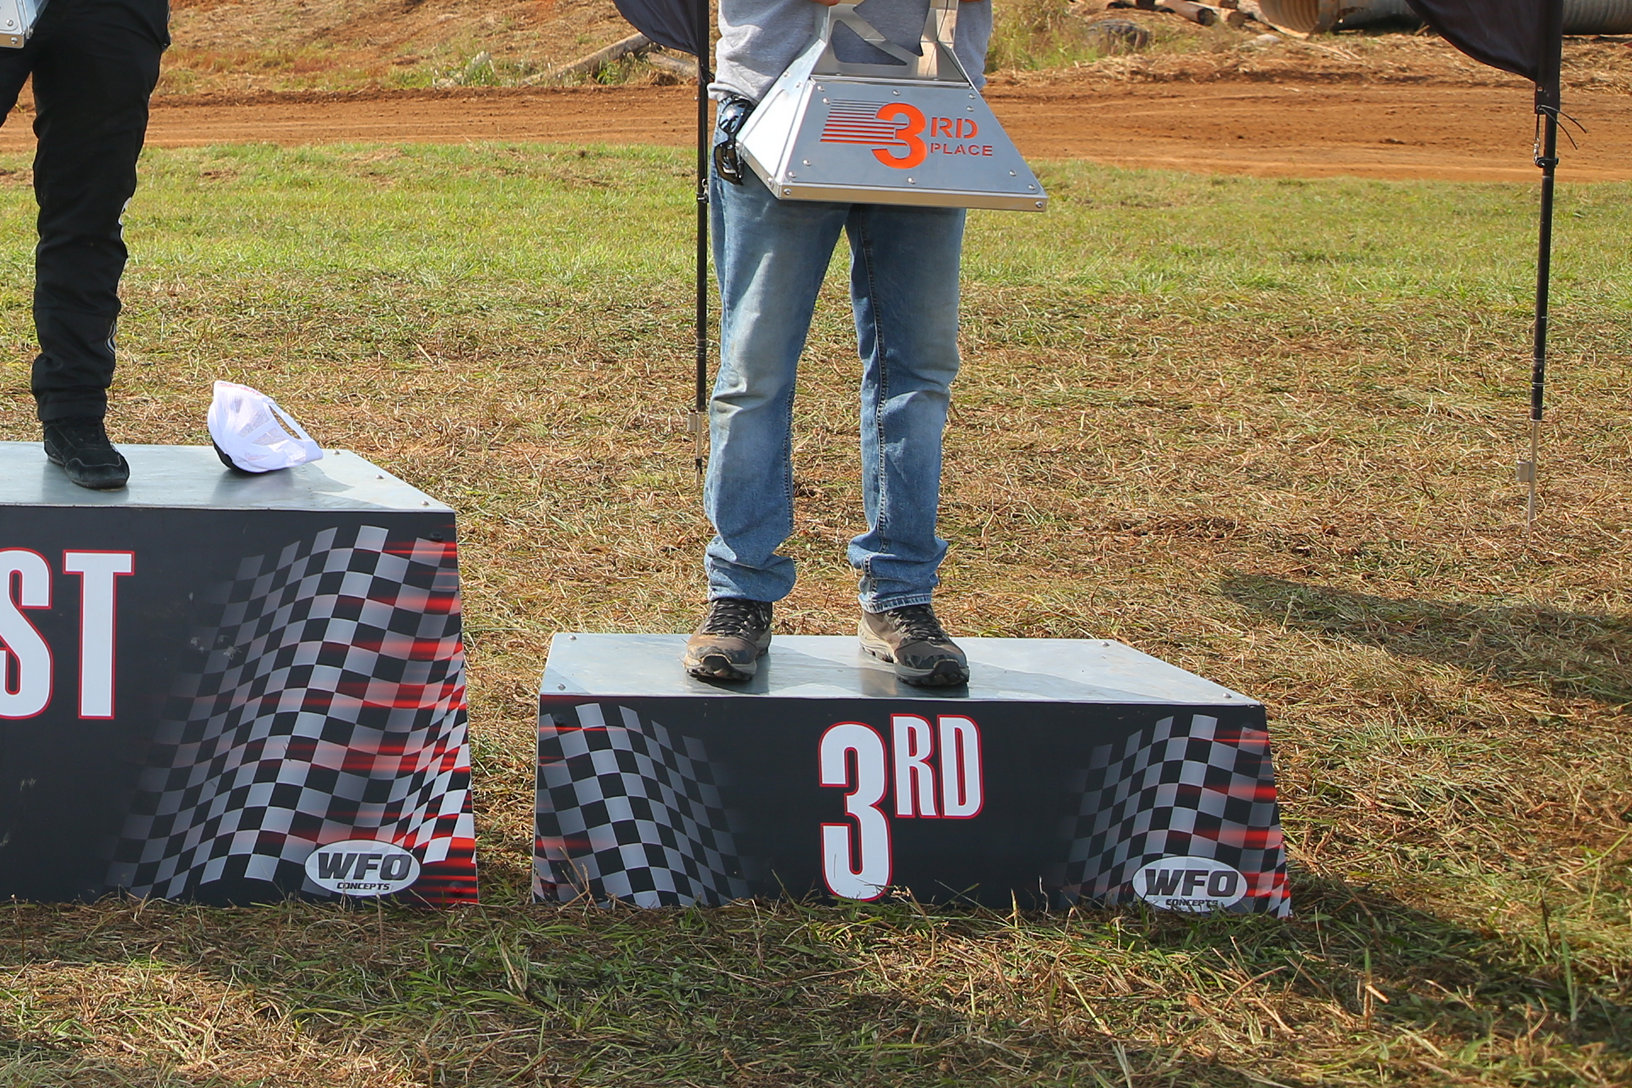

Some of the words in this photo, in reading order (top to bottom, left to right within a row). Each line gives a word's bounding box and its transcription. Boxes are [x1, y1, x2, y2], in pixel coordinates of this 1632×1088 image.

[871, 102, 978, 170] 3RD
[930, 142, 994, 157] PLACE
[818, 712, 984, 902] 3RD
[317, 852, 413, 881] WFO
[336, 882, 390, 891] CONCEPTS
[1144, 868, 1239, 898] WFO
